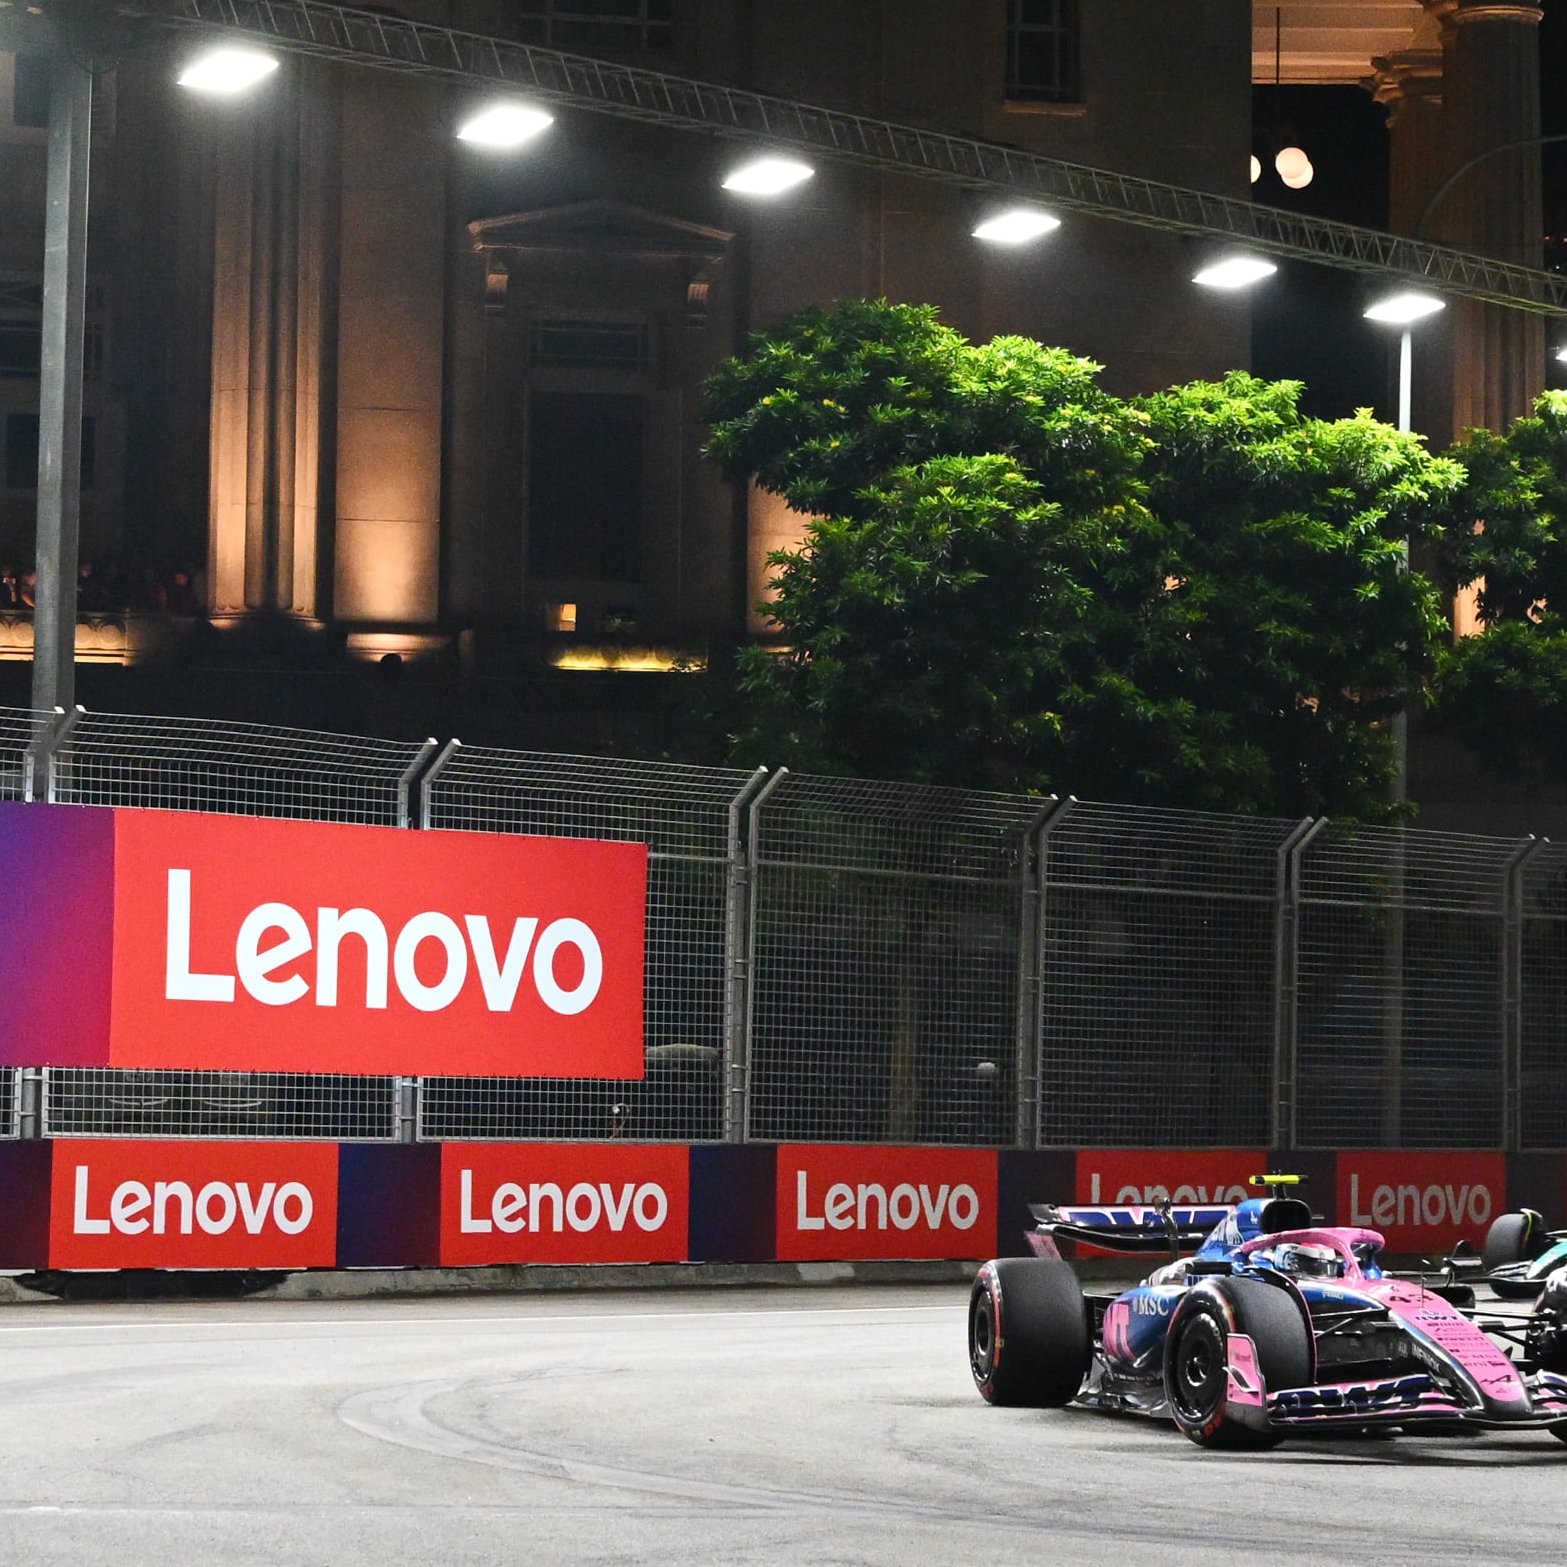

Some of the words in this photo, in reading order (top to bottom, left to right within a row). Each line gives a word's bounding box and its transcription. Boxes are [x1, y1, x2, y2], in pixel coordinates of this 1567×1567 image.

[165, 868, 604, 1016] Lenovo
[73, 1165, 314, 1235] Lenovo
[460, 1168, 668, 1233] Lenovo
[796, 1170, 979, 1231] Lenovo
[1350, 1173, 1492, 1226] Lenovo
[1138, 1294, 1170, 1316] MSC
